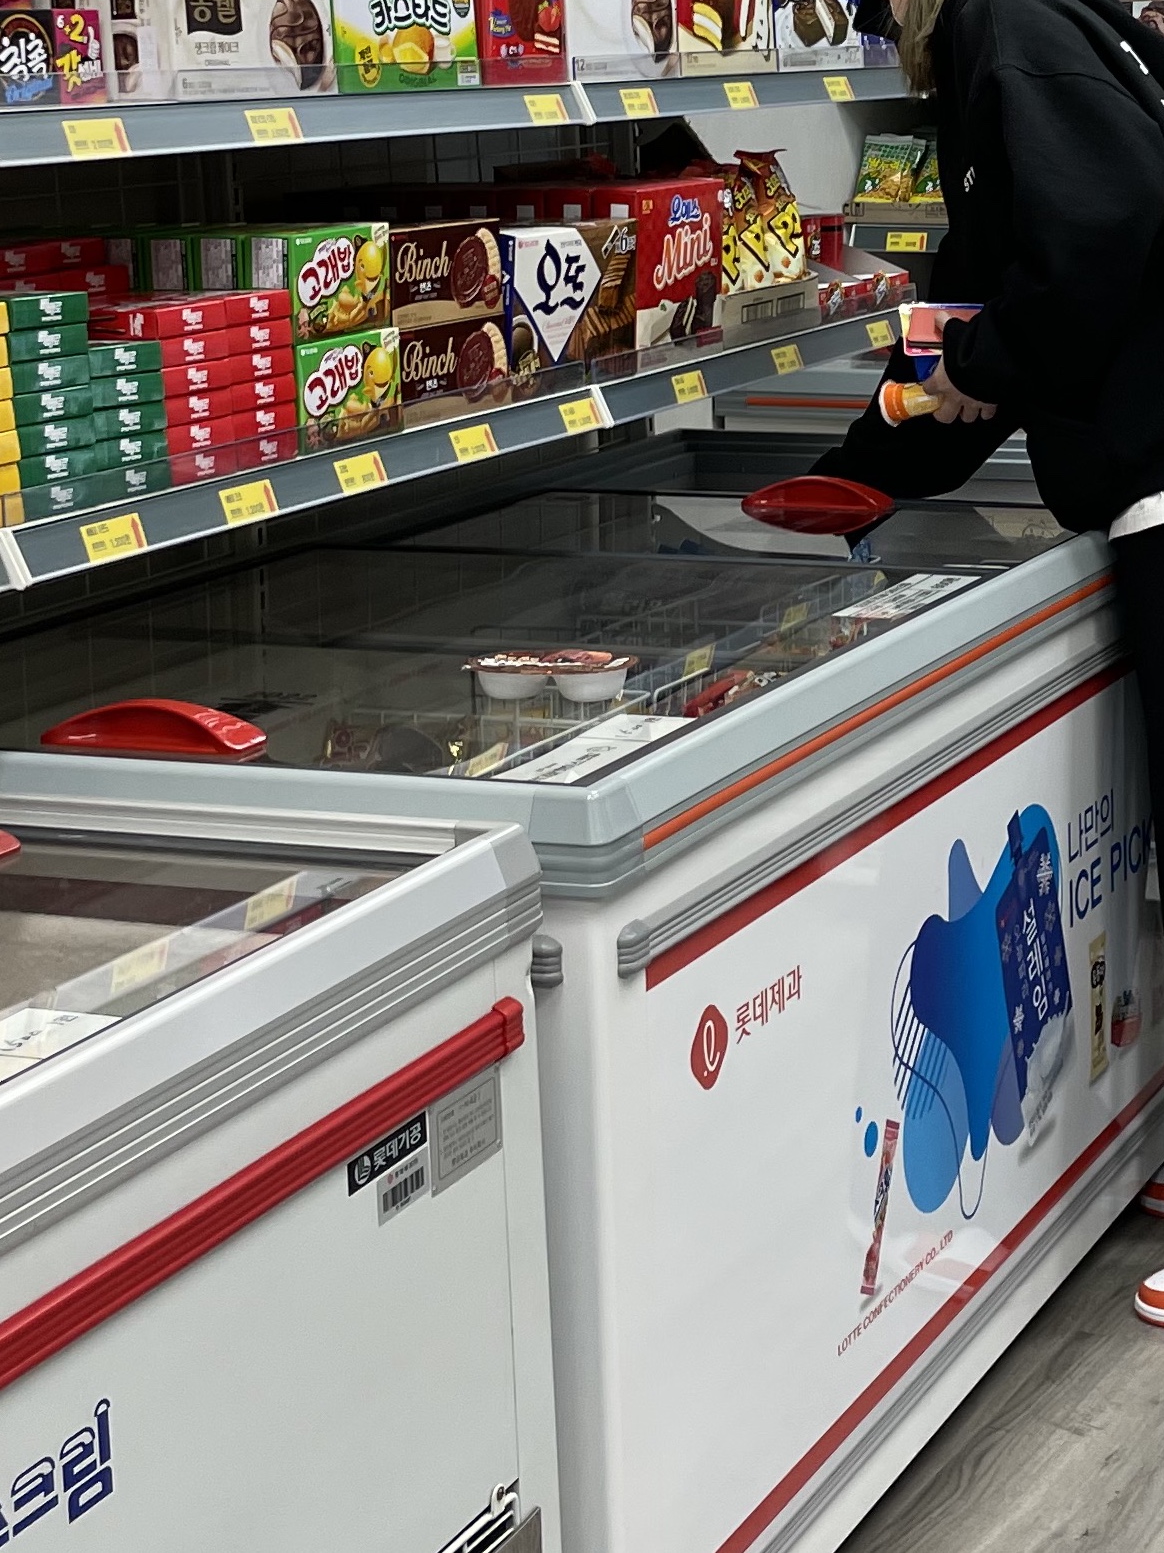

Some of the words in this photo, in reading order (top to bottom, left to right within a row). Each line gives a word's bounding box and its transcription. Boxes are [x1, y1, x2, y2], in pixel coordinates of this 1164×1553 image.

[669, 193, 701, 226] 오예스
[300, 238, 355, 306] 고래밥
[395, 240, 451, 285] Binch
[533, 238, 590, 315] 오뜨
[653, 222, 714, 292] Mini
[304, 346, 364, 416] 고래밥
[402, 347, 459, 393] Binch
[1065, 787, 1116, 864] 나만의
[1068, 859, 1102, 929] ICE
[1109, 811, 1156, 888] PICK
[1020, 896, 1050, 1022] 설레임
[734, 963, 804, 1045] 롯데제과
[372, 1121, 422, 1172] 롯데기공
[836, 1323, 863, 1358] LOTTE
[862, 1257, 926, 1332] CONFECTIONERY
[0, 1397, 115, 1548] 크림
